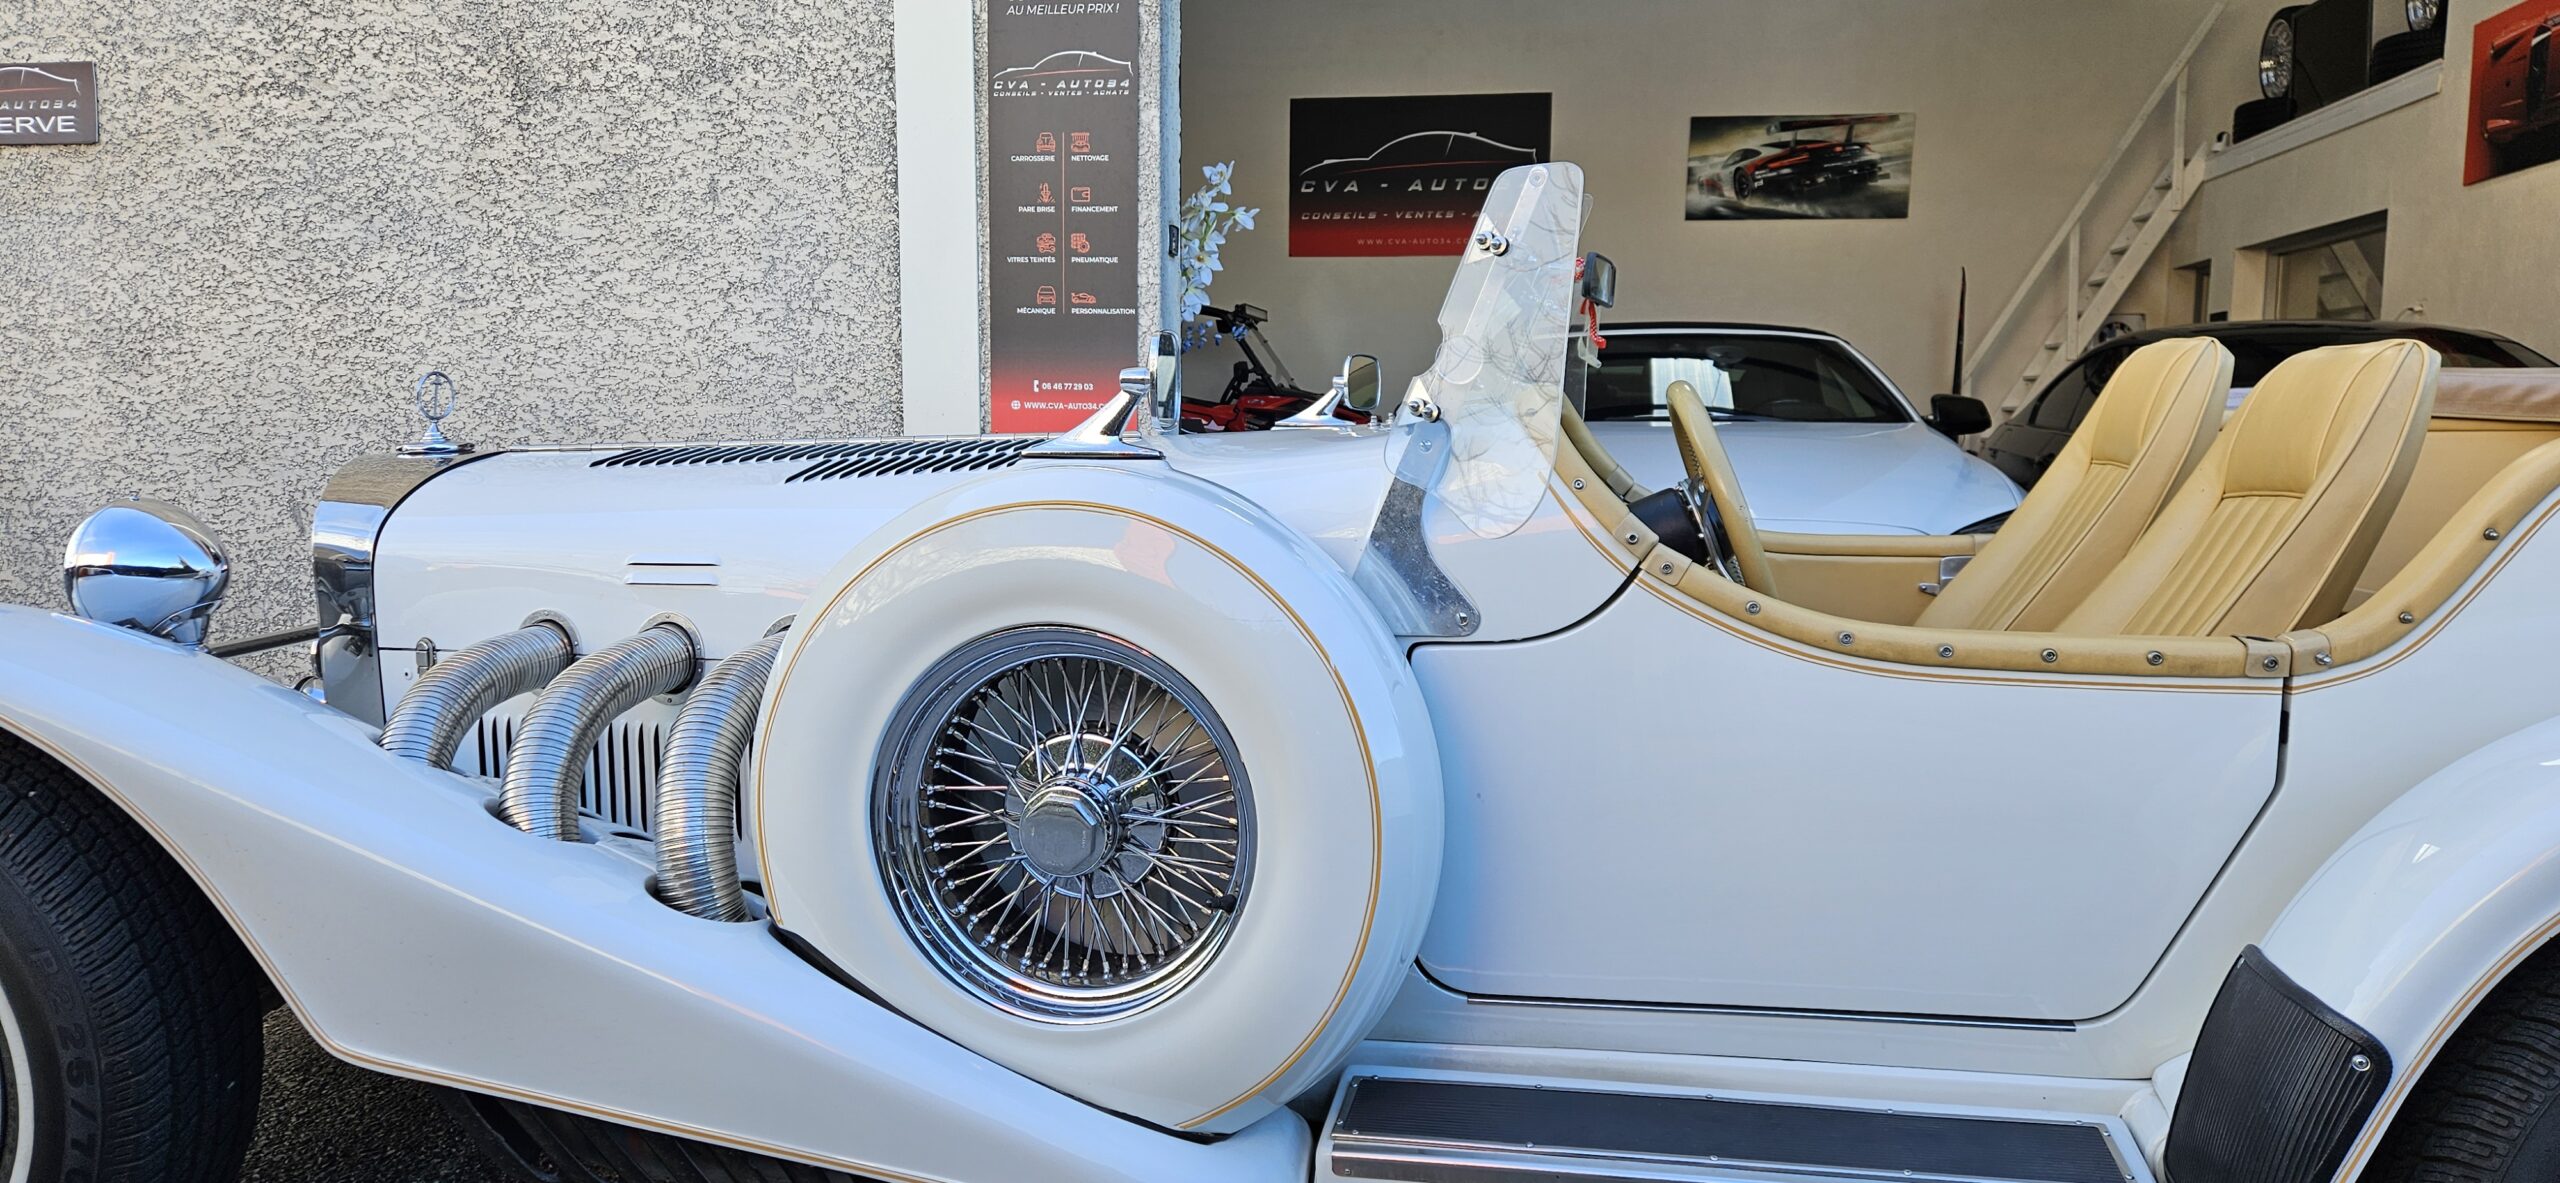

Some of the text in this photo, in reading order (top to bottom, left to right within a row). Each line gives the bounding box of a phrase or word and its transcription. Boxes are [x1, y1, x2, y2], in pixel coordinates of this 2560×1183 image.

[1006, 5, 1024, 15] AU
[1026, 3, 1085, 15] MEILLEUR
[1087, 3, 1114, 14] PRIX
[993, 81, 1029, 89] CVA
[1056, 78, 1129, 88] AUTO34
[1301, 180, 1359, 193] CVA
[1407, 177, 1509, 192] AUTO
[1301, 211, 1377, 220] CONSEILS
[1395, 210, 1455, 219] VENTES
[1071, 256, 1118, 264] PNEUMATIQUE
[1016, 306, 1056, 315] MÉCANIQUE
[1071, 307, 1135, 315] PERSONNALISATION
[1042, 382, 1052, 390] 06
[1053, 382, 1063, 390] 46
[1083, 383, 1094, 391] 03
[1024, 402, 1105, 410] WWW.CVA-AUTO34.C
